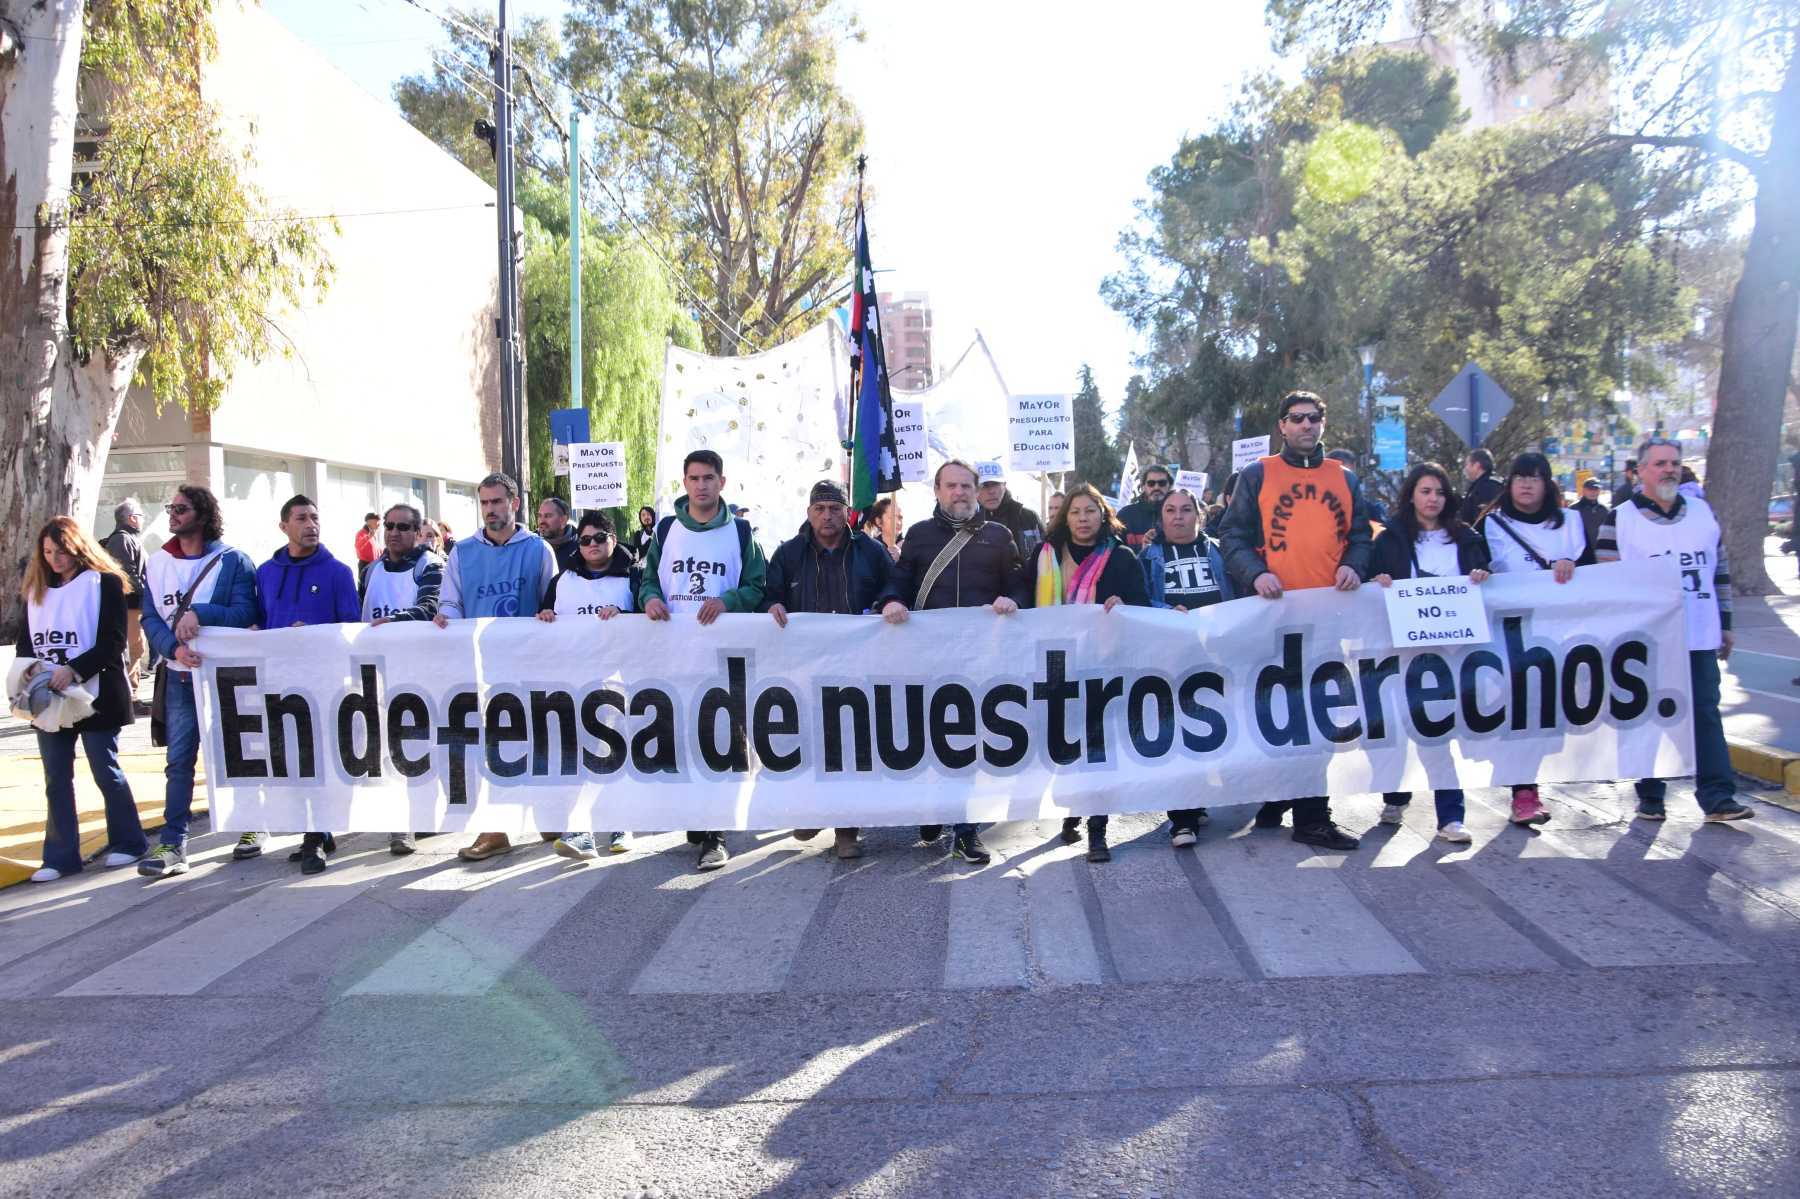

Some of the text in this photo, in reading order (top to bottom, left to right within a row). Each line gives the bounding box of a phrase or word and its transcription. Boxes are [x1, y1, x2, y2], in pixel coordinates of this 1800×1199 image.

[1020, 400, 1060, 410] MAYOR
[1009, 416, 1071, 424] PRESUPUESTO
[580, 448, 614, 457] MAYOR
[672, 556, 726, 577] aten
[1398, 584, 1468, 598] EL SALARIO
[1417, 606, 1441, 618] NO
[1408, 628, 1474, 641] GANANCIA
[216, 615, 1678, 805] En defensa de nuestros derechos.
